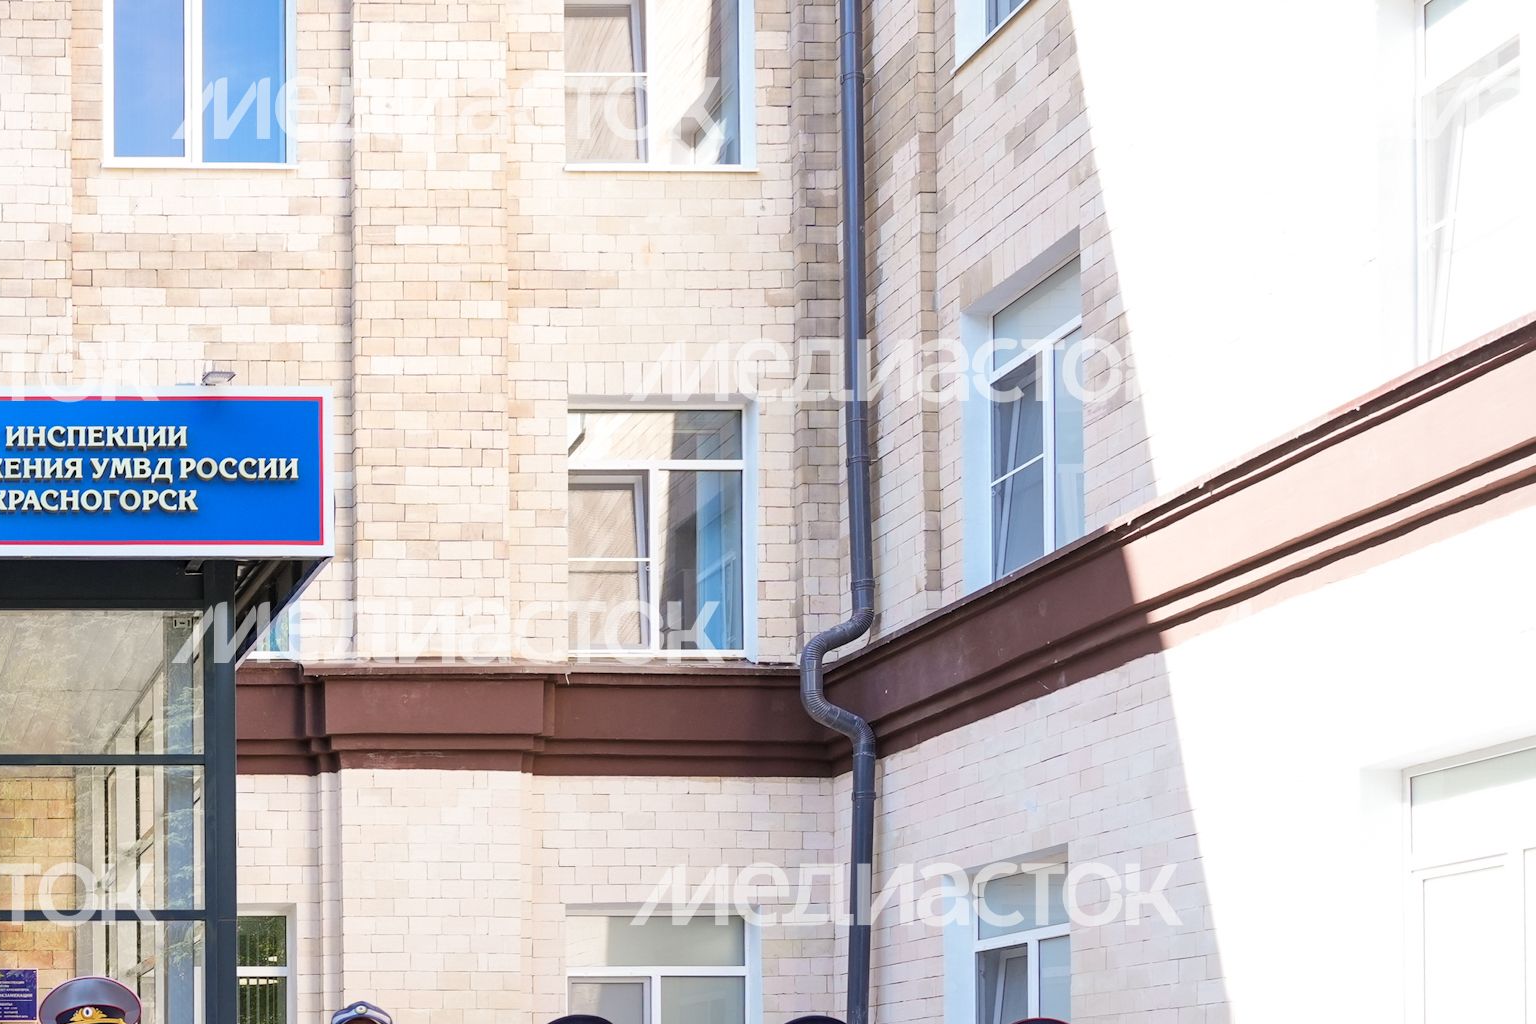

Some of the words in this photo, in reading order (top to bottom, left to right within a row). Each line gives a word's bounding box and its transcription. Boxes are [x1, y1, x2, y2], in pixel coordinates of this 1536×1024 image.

[5, 425, 188, 451] ИНСПЕКЦИИ
[90, 457, 174, 484] УМВД
[179, 457, 299, 481] РОССИИ
